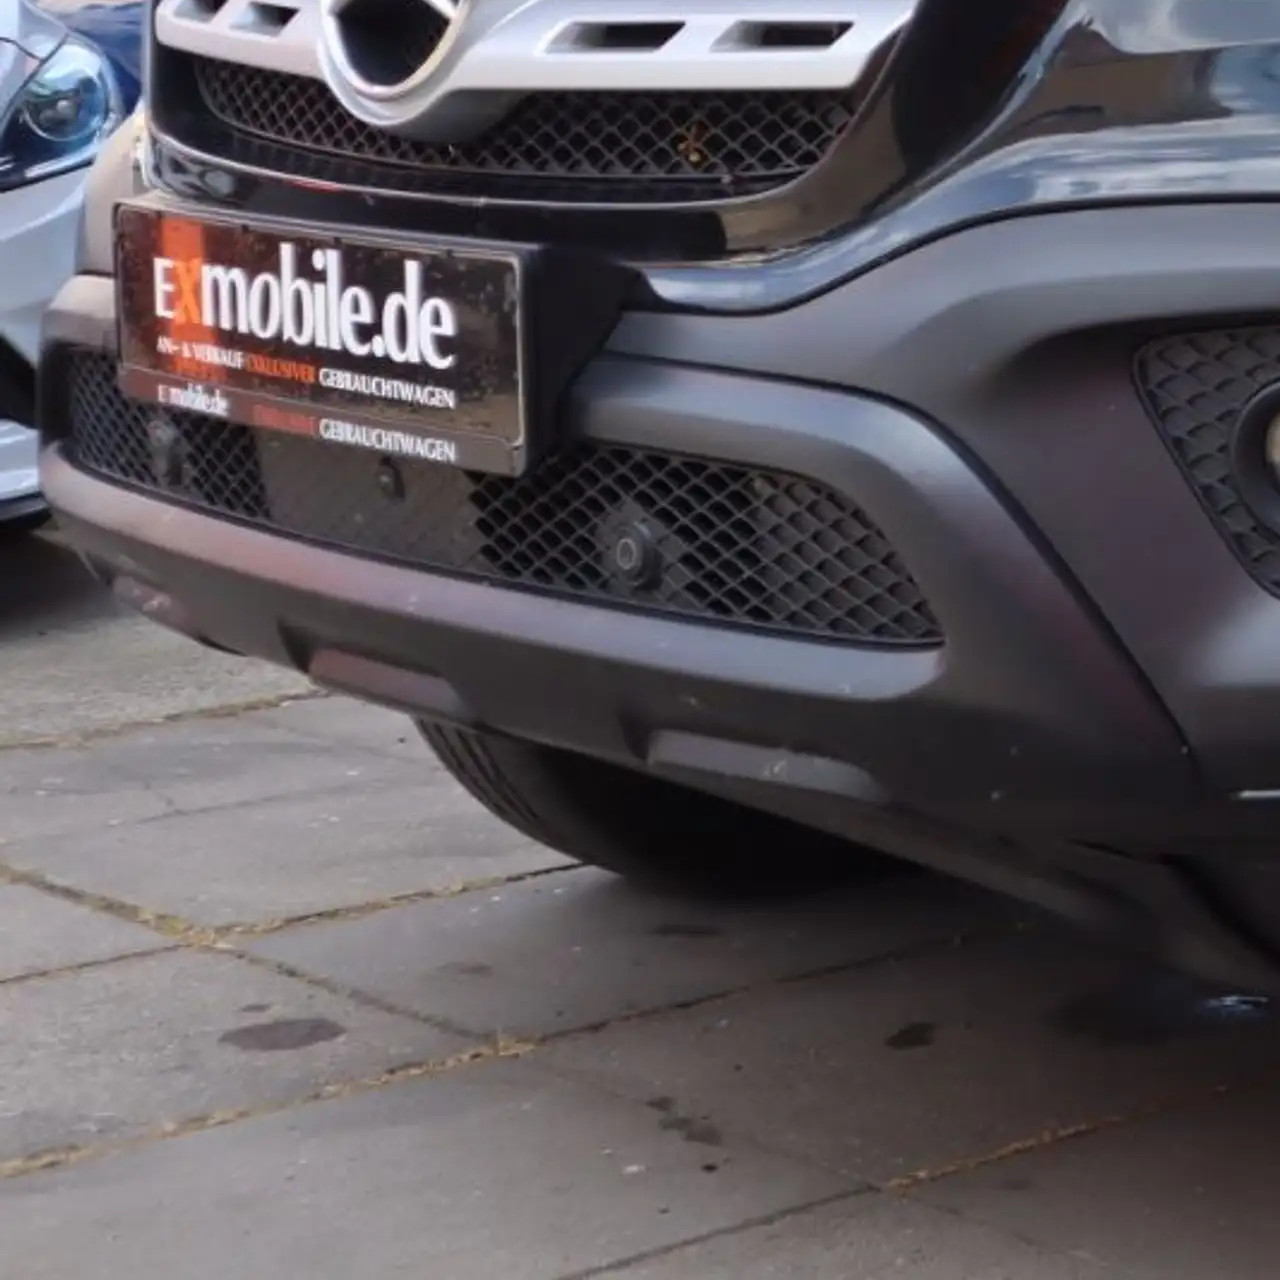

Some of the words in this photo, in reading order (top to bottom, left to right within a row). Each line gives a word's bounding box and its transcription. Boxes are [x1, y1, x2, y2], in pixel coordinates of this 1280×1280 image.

[153, 241, 456, 370] EXmobile.de
[319, 367, 456, 410] GEBRAUCHTWAGEN
[319, 417, 456, 462] GEBRAUCHTWAGEN
